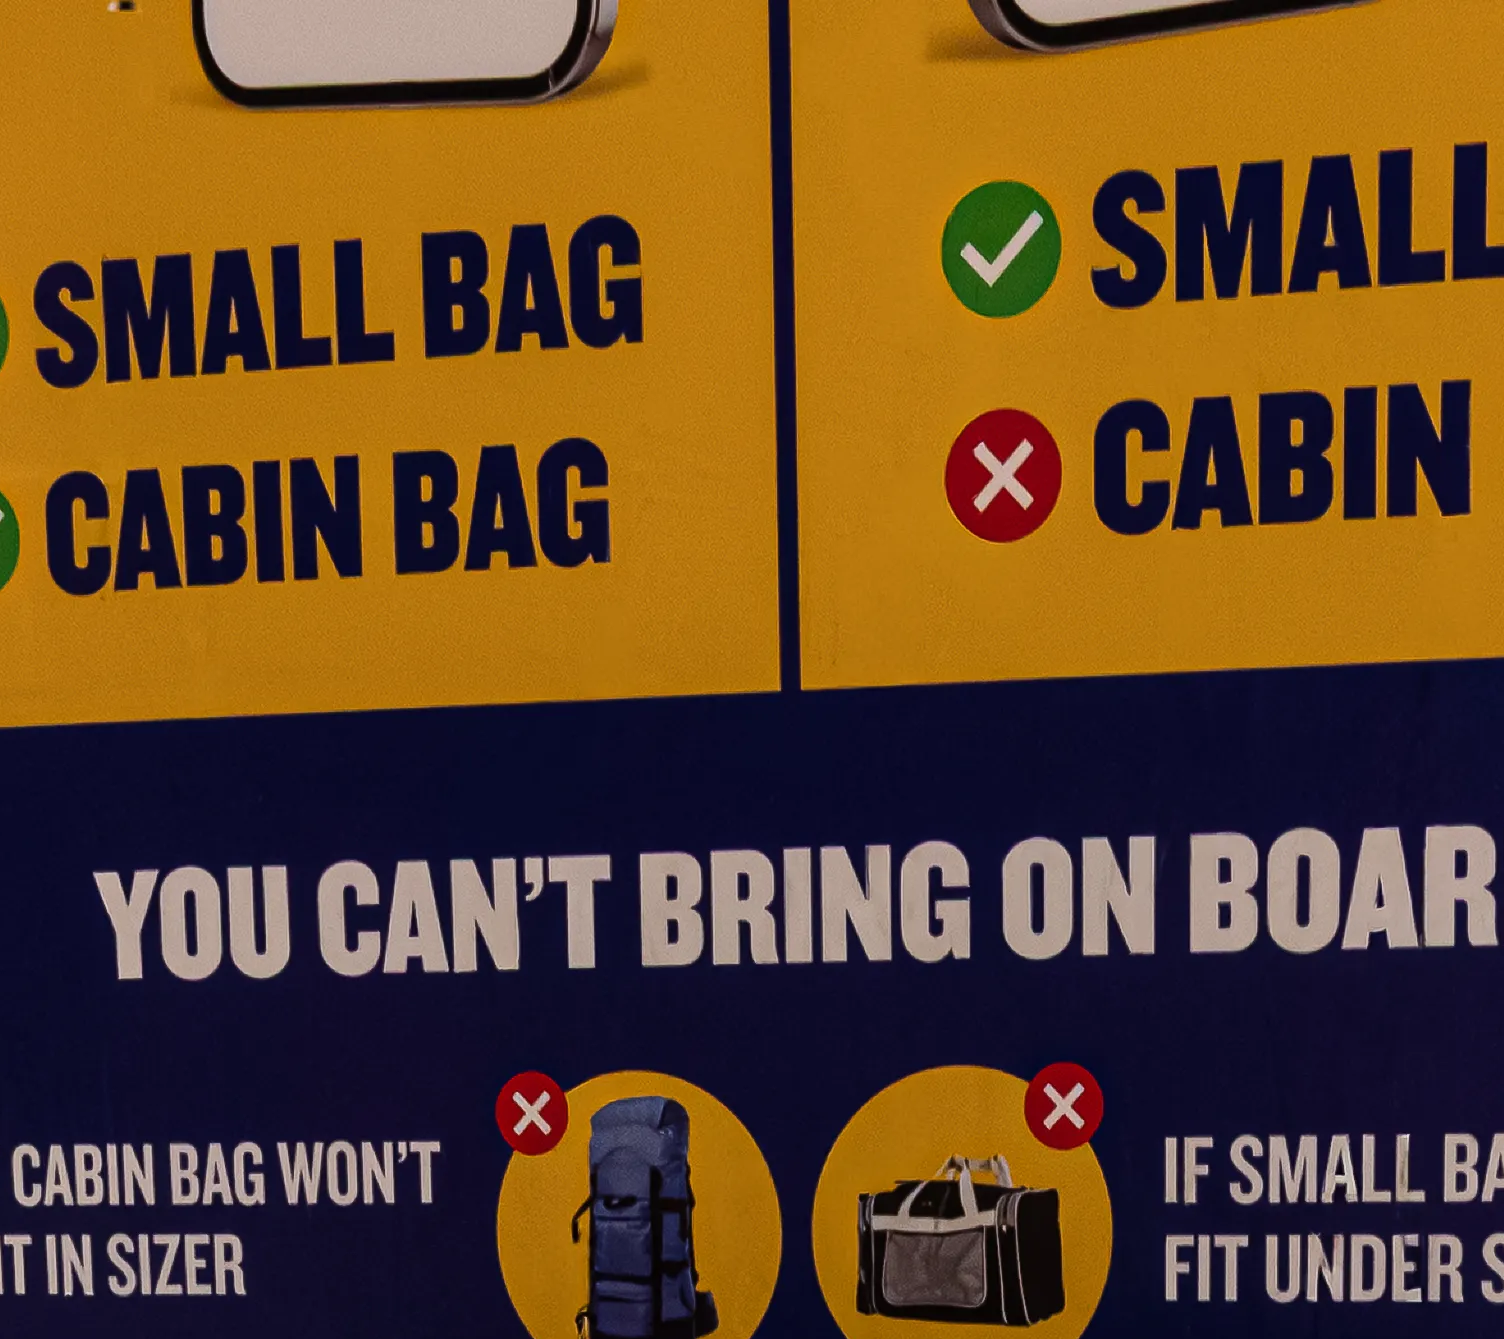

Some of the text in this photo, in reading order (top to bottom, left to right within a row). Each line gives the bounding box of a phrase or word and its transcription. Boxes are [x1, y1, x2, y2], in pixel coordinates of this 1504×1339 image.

[33, 214, 643, 389] SMALL BAG
[1093, 379, 1471, 536] CABIN
[45, 437, 611, 596] CABIN BAG
[93, 864, 291, 980] YOU
[317, 854, 611, 977] CAN’T
[639, 840, 971, 967] BRING
[1002, 835, 1155, 960] ON
[12, 1142, 156, 1207] CABIN
[169, 1141, 266, 1206] BAG
[276, 1140, 441, 1206] WON’T
[1165, 1135, 1214, 1204] IF
[1229, 1133, 1426, 1204] SMALL
[45, 1233, 94, 1297] IN
[106, 1232, 248, 1296] SIZER
[1165, 1234, 1249, 1302] FIT
[1265, 1233, 1464, 1303] UNDER
